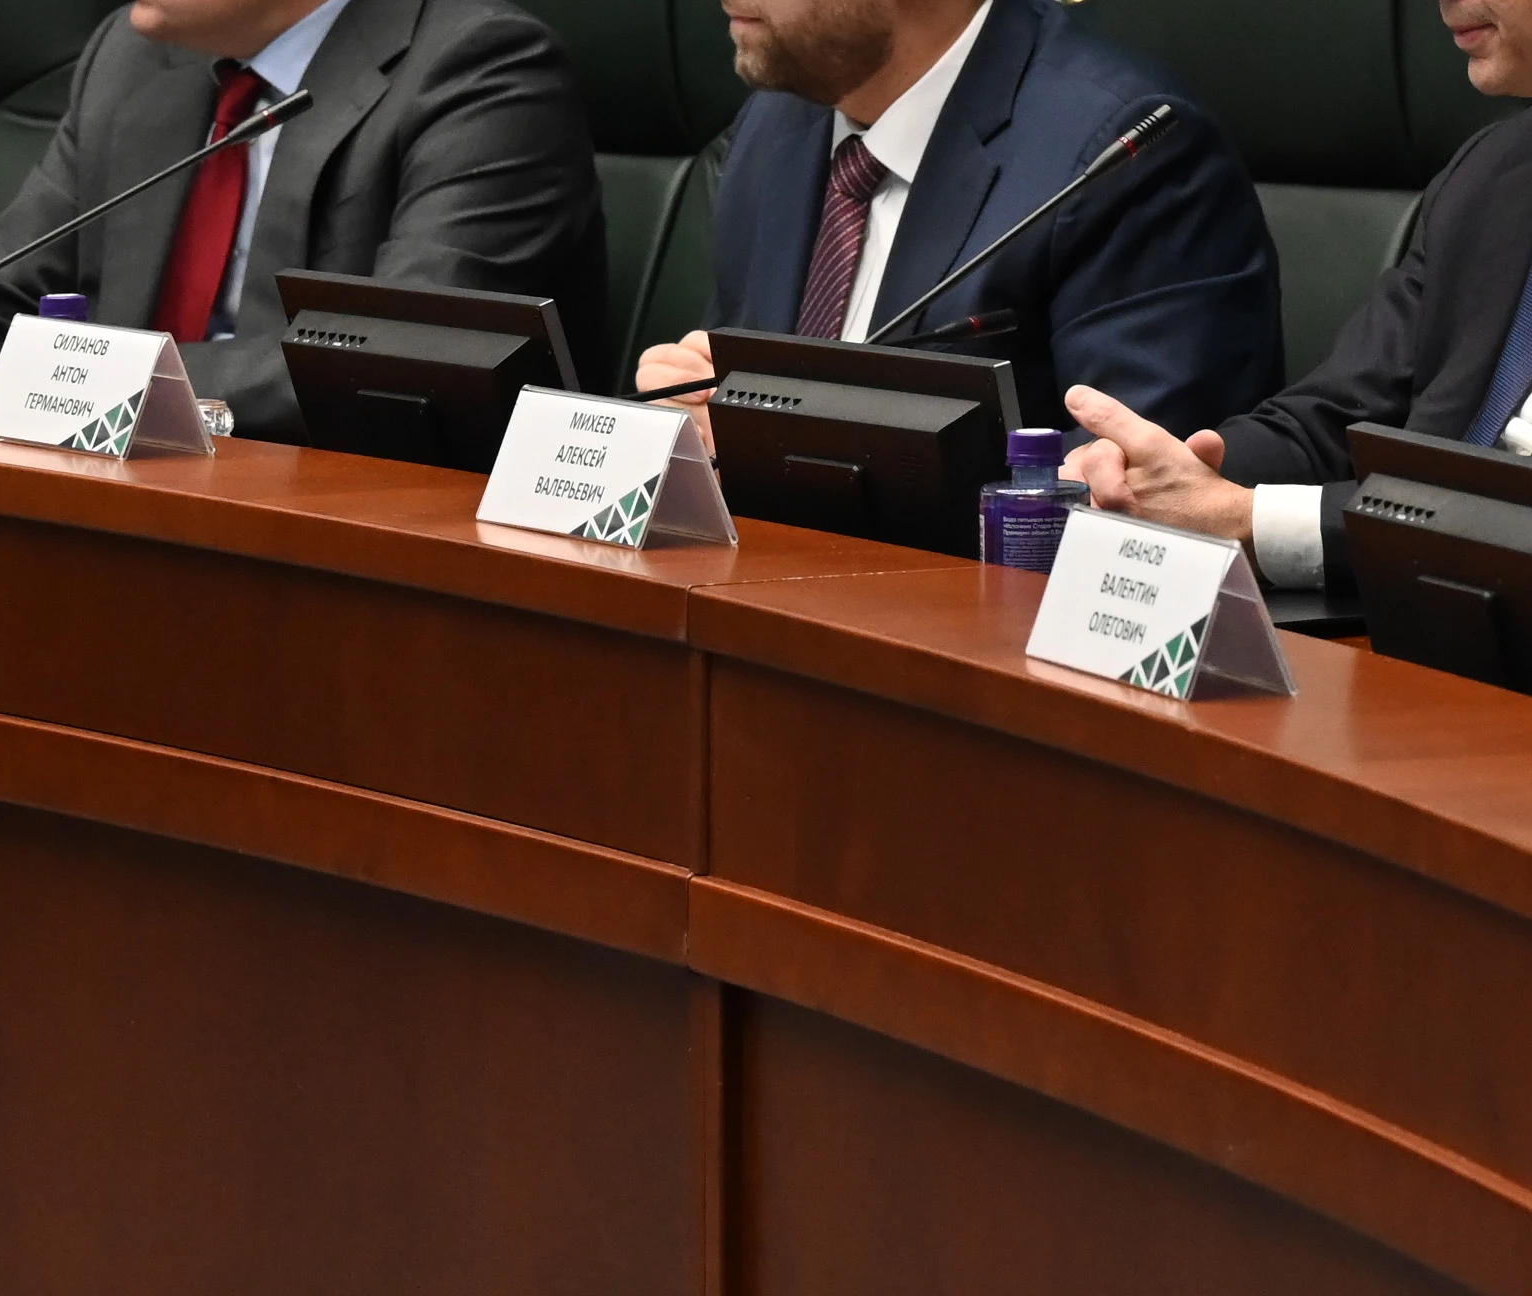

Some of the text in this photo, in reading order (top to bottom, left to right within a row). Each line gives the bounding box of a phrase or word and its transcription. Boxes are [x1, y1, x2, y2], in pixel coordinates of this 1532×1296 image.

[53, 333, 110, 356] СИЛУАНОВ
[51, 364, 88, 385] АНТОН
[24, 392, 95, 418] ГЕРМАНОВИЧ
[569, 411, 617, 435] МИХЕЕВ
[555, 444, 608, 469] АЛЕКСЕЙ
[534, 475, 606, 504] ВАЛЕРЬЕВИЧ
[1118, 537, 1167, 567] ИВАНОВ
[1100, 572, 1160, 607] ВАЛЕНТИН
[1088, 611, 1148, 645] ОЛЕГОВИЧ
